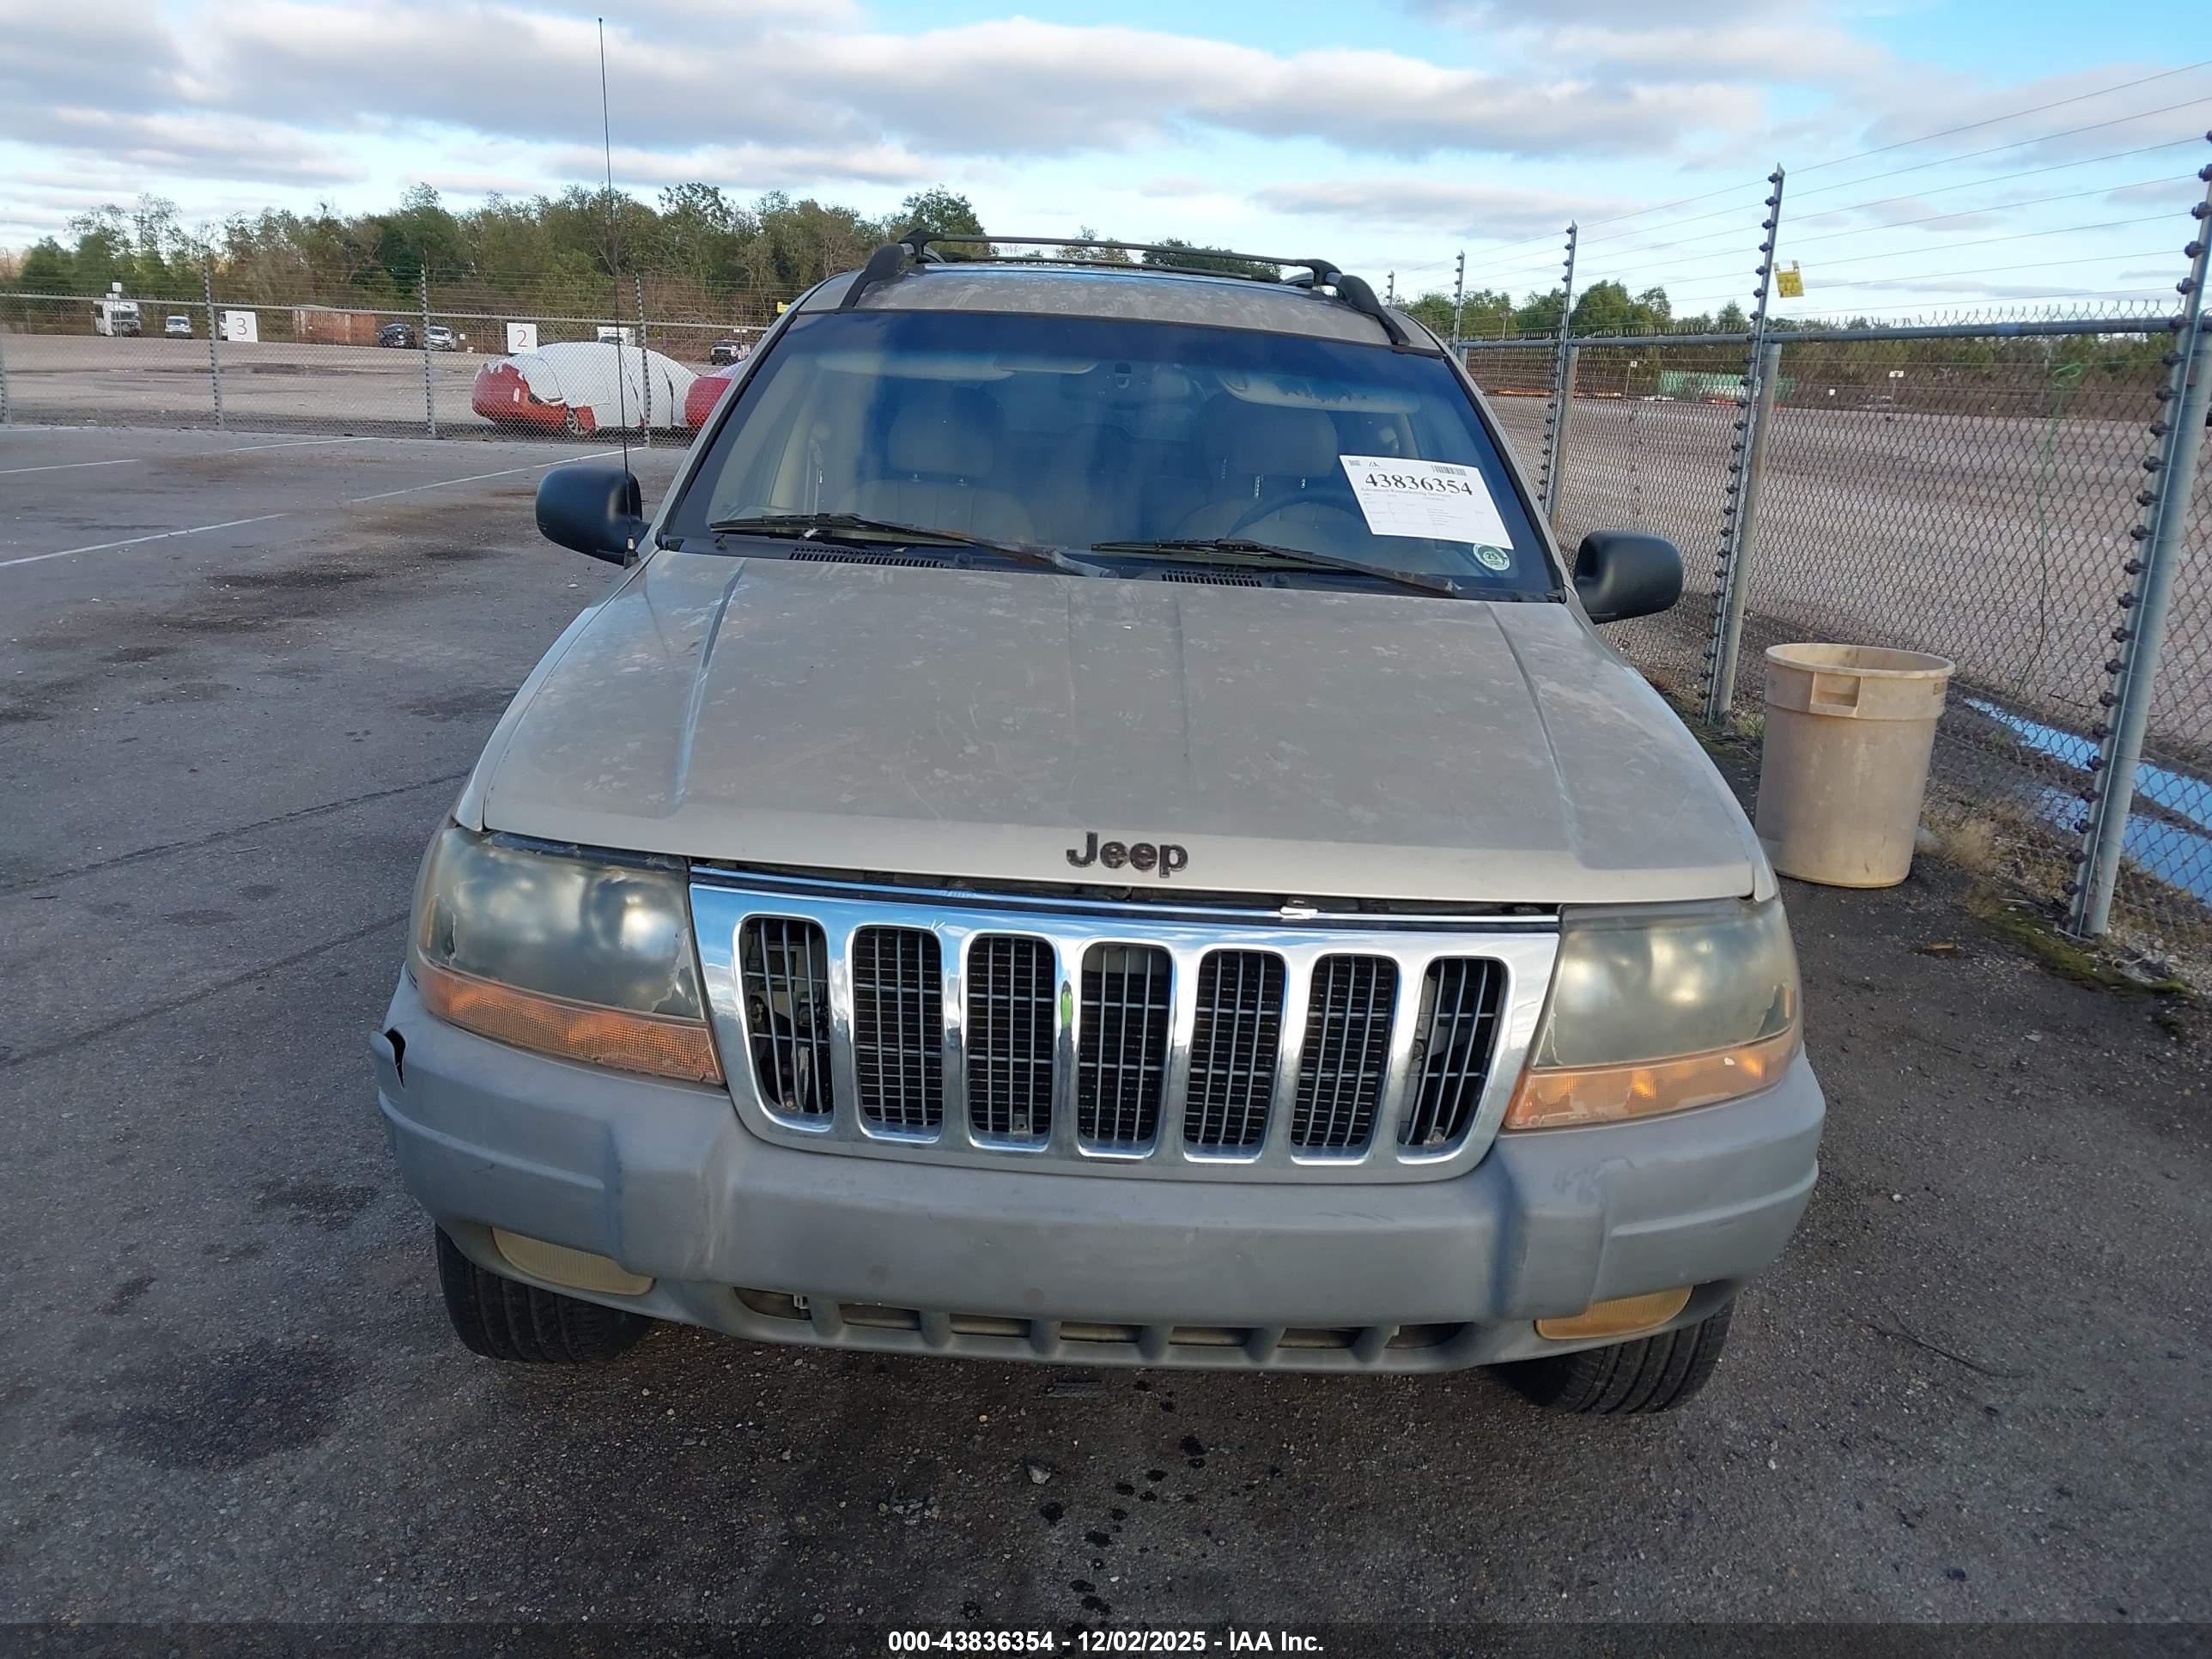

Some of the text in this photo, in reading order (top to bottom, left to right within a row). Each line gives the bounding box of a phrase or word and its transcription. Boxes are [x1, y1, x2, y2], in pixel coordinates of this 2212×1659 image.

[235, 317, 247, 336] 3
[516, 329, 529, 348] 2
[1364, 473, 1474, 496] 43836354
[1066, 830, 1189, 878] Jeep
